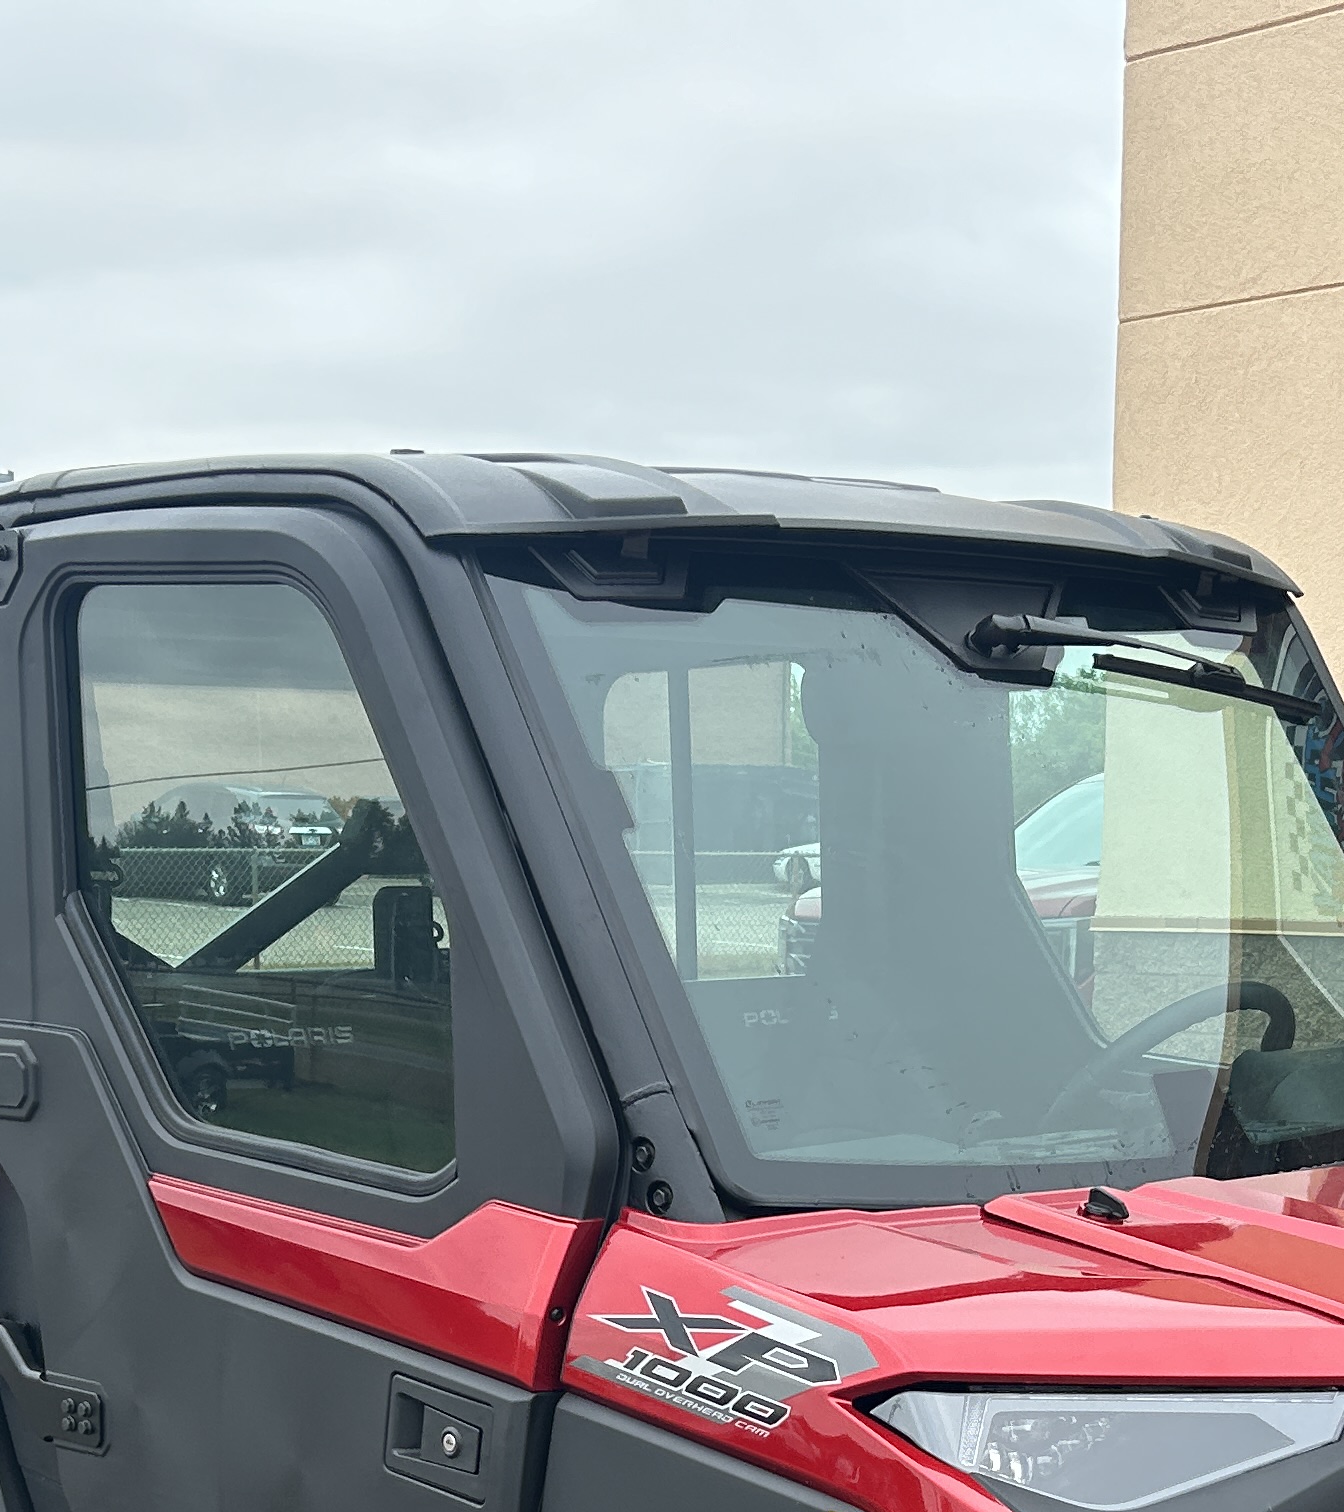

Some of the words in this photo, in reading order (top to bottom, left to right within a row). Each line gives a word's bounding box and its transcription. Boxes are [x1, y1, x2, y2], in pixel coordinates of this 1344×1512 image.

[227, 1025, 354, 1051] POLARIS
[586, 1284, 843, 1388] XP
[615, 1373, 653, 1393] DUAL
[655, 1387, 734, 1424] OVERHEAD
[735, 1419, 771, 1439] CAM
[620, 1346, 793, 1431] 1000
